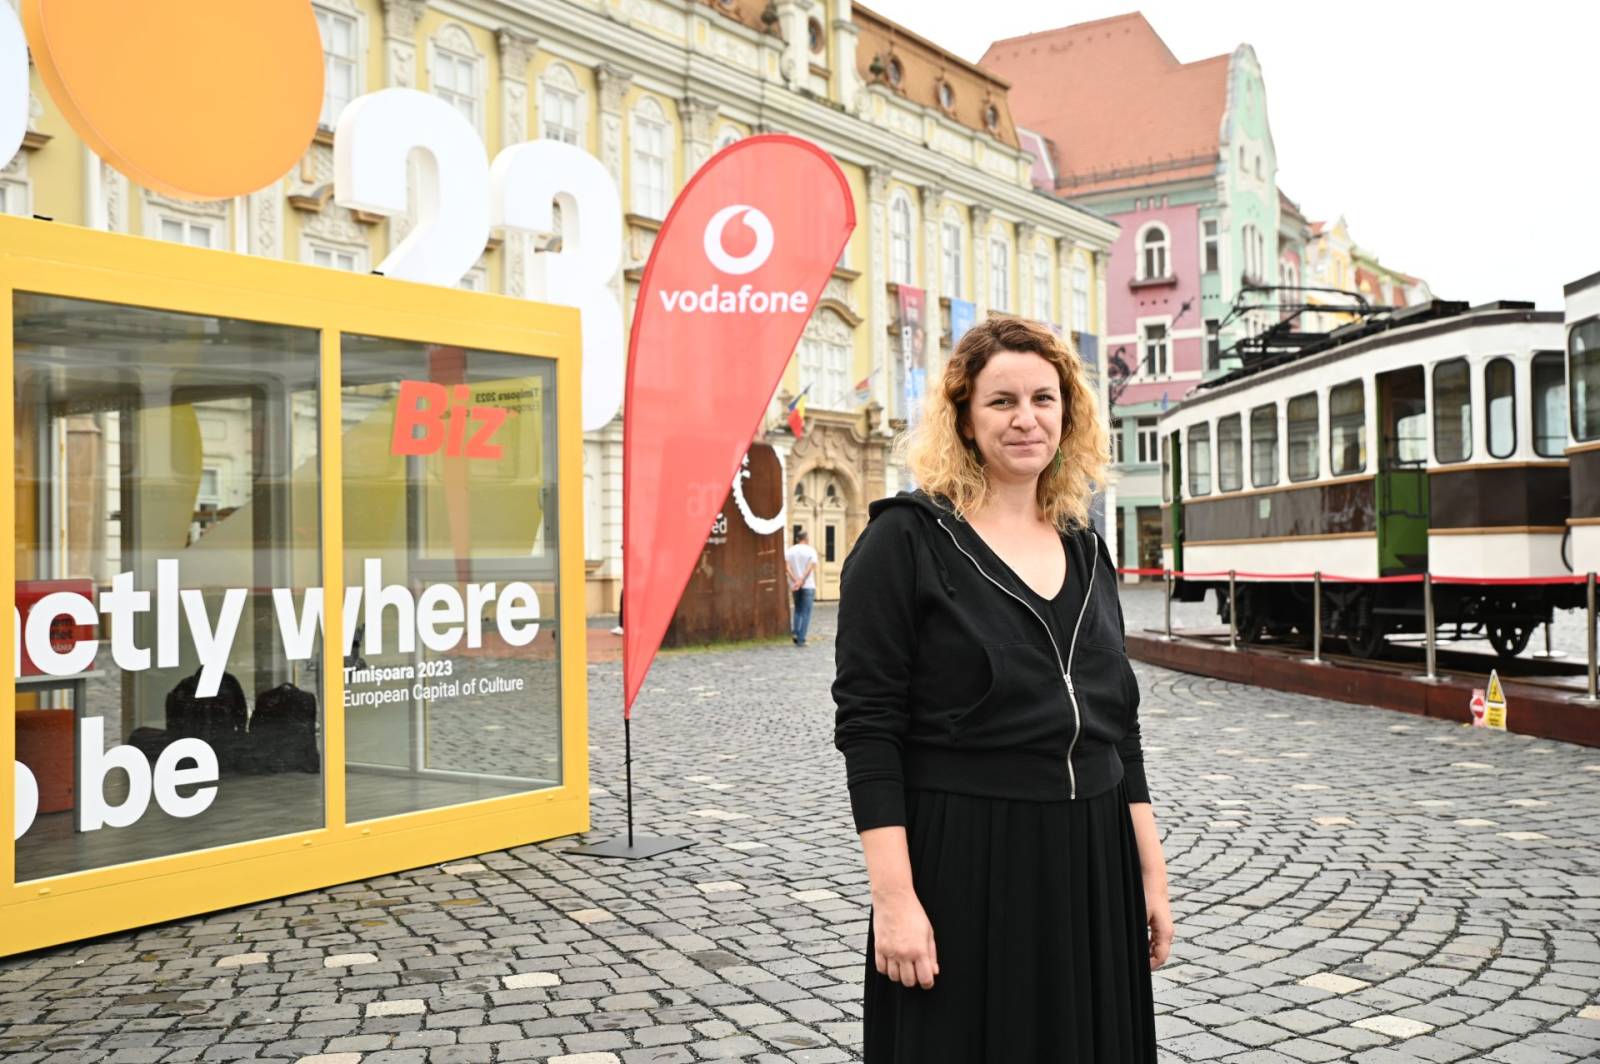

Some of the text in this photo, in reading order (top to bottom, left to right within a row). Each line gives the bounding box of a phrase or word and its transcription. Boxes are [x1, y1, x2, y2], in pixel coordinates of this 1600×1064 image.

[659, 284, 809, 313] vodafone
[391, 380, 507, 460] Biz
[272, 558, 540, 661] where
[343, 661, 453, 687] Timișoara 2023
[343, 676, 524, 708] European Capital of Culture
[80, 716, 219, 832] be
